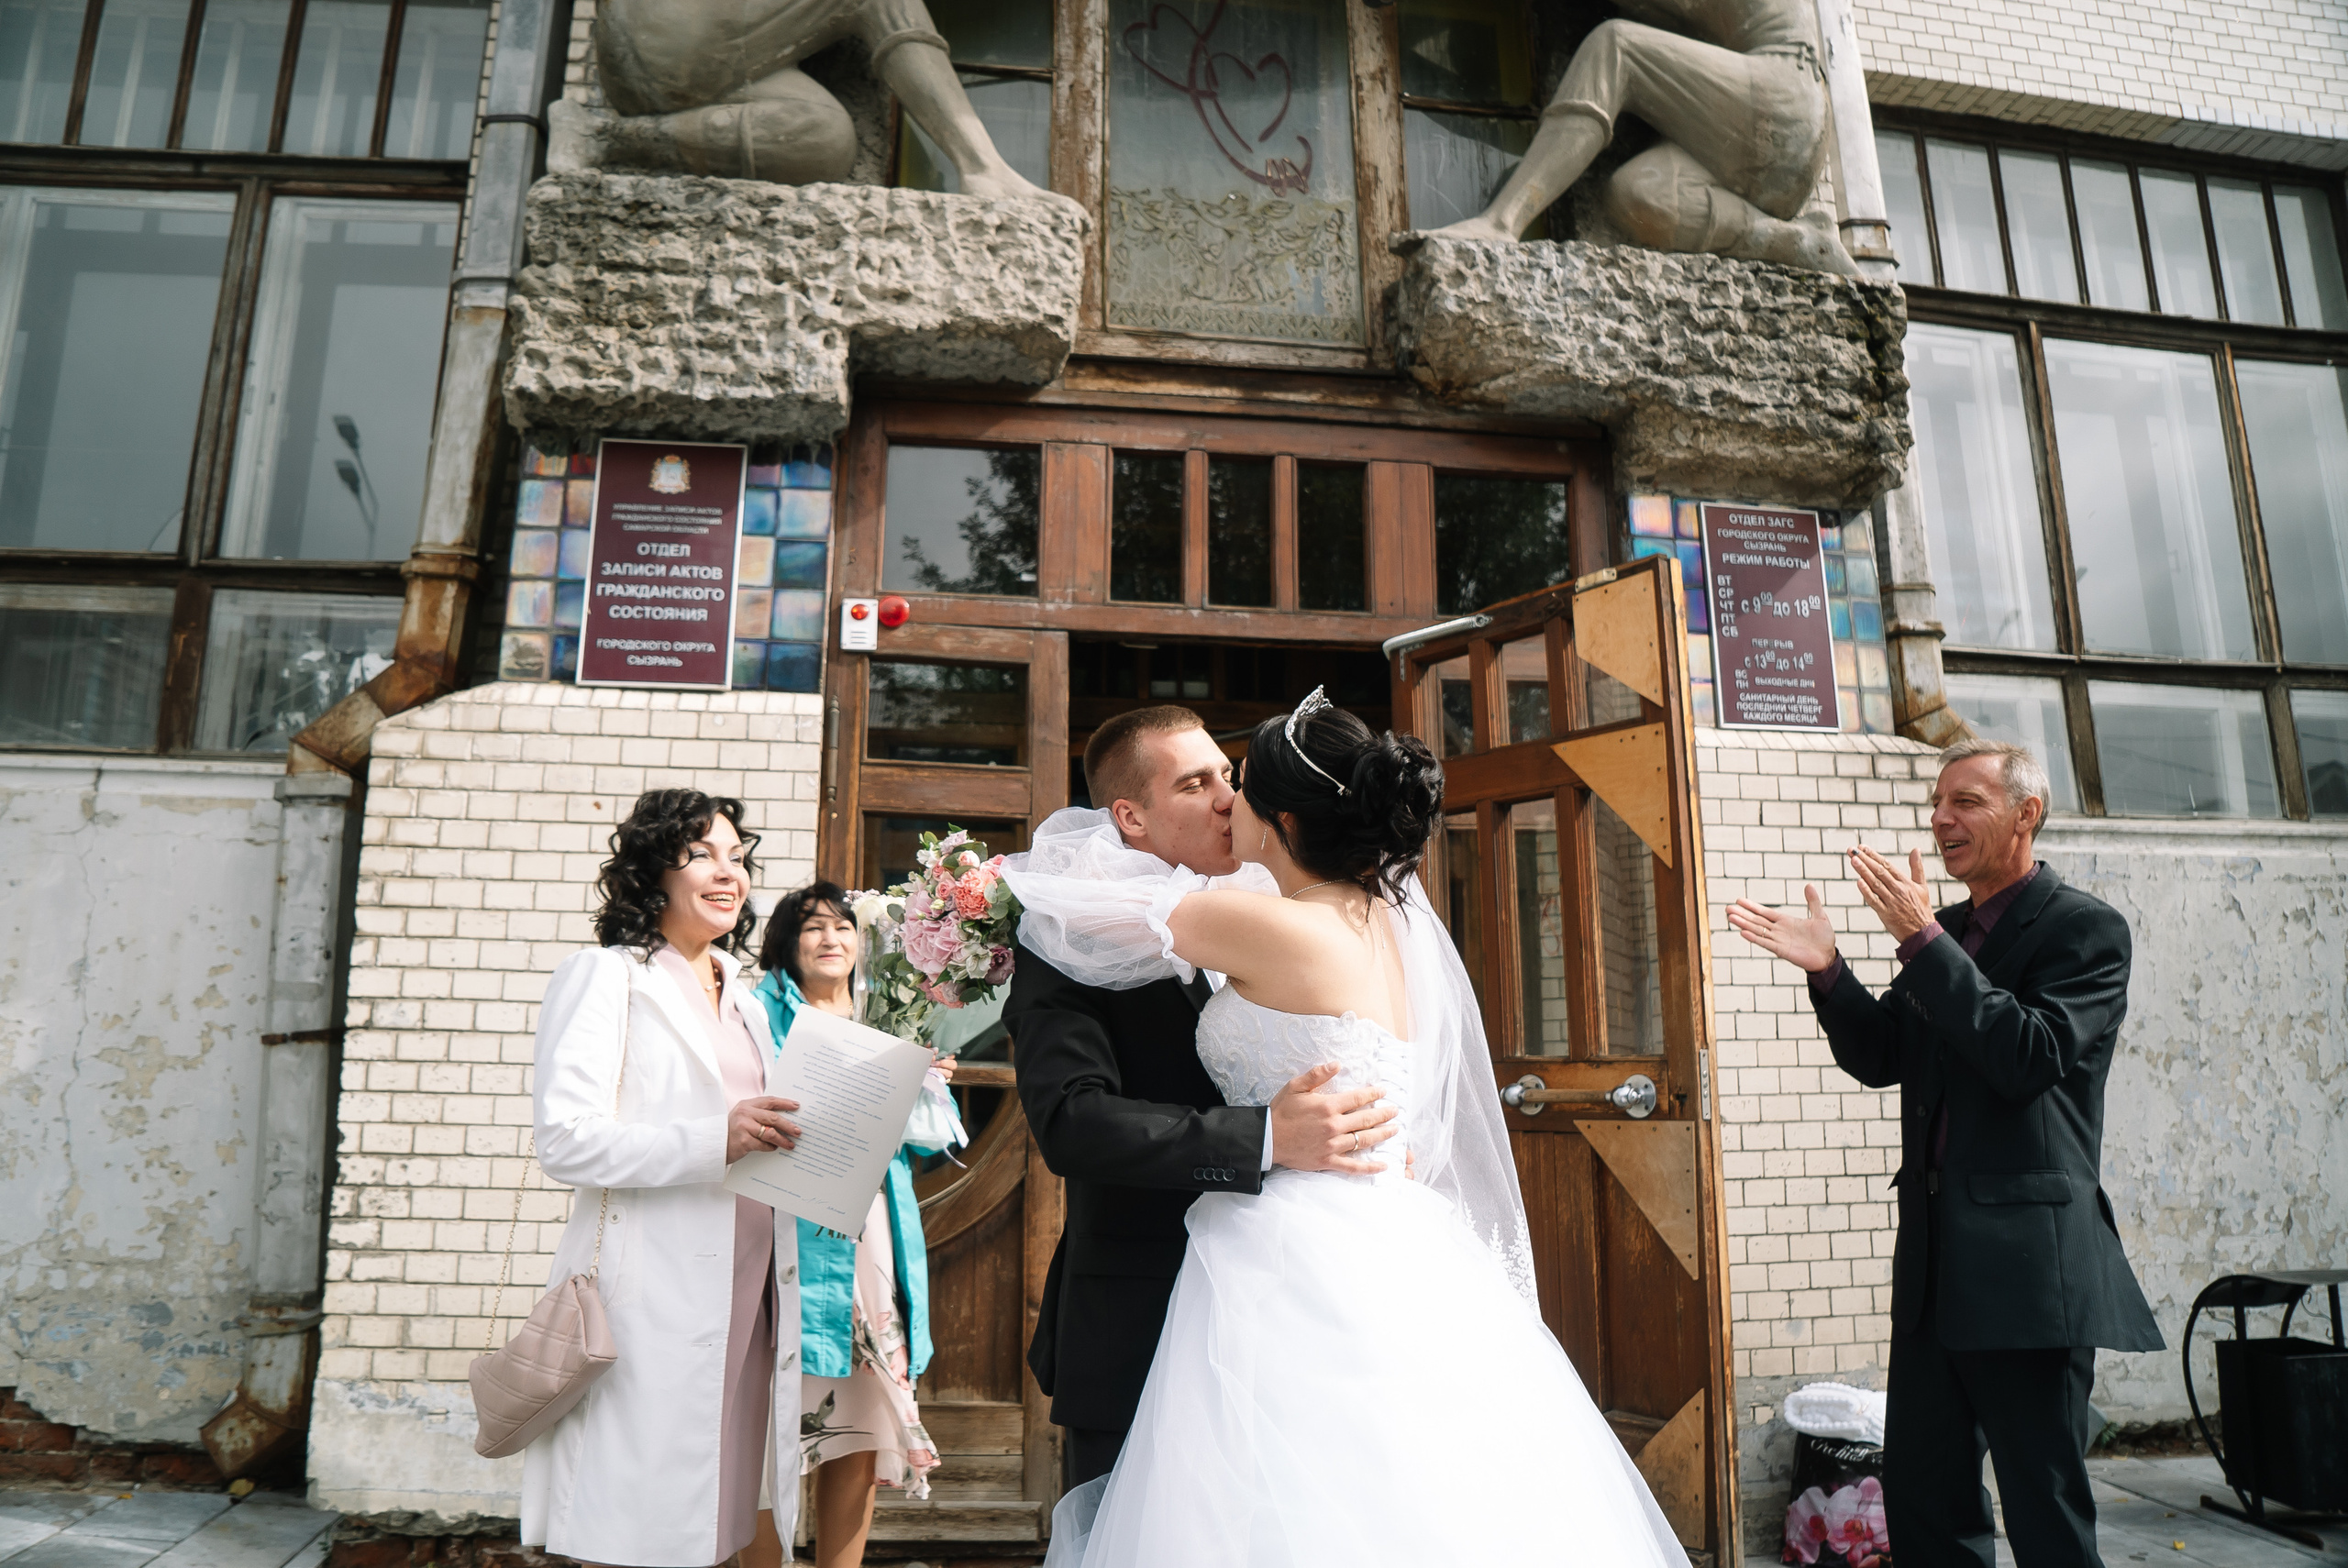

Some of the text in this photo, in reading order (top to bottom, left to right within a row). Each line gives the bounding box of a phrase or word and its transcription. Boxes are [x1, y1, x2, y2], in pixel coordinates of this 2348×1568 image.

[1729, 513, 1795, 529] ОТДЕЛ ЗАГС
[1717, 527, 1811, 545] ГОРОДСКОГО ОКРУГА
[637, 542, 691, 558] ОТДЕЛ
[1744, 540, 1788, 553] СЫЗРАНЬ
[1722, 552, 1811, 570] РЕЖИМ РАБОТЫ
[601, 561, 724, 580] ЗАПИСИ АКТОВ
[1717, 574, 1732, 587] ВТ
[596, 582, 725, 602] ГРАЖДАНСКОГО
[1718, 587, 1734, 600] СР
[1720, 600, 1734, 612] ЧТ
[609, 604, 709, 622] СОСТОЯНИЯ
[1721, 613, 1736, 624] ПТ
[1722, 625, 1739, 638] СБ
[596, 637, 716, 654] ГОРОДСКОГО ОКРУГА
[1734, 669, 1748, 679] ВС
[1735, 679, 1749, 690] ПН
[1755, 677, 1799, 688] ВЫХОДНЫЕ
[1739, 692, 1819, 706] САНИТАРНЫЙ ДЕНЬ
[1788, 704, 1823, 715] ЧЕТВЕРГ
[1743, 712, 1819, 725] КАЖДОГО МЕСЯЦА
